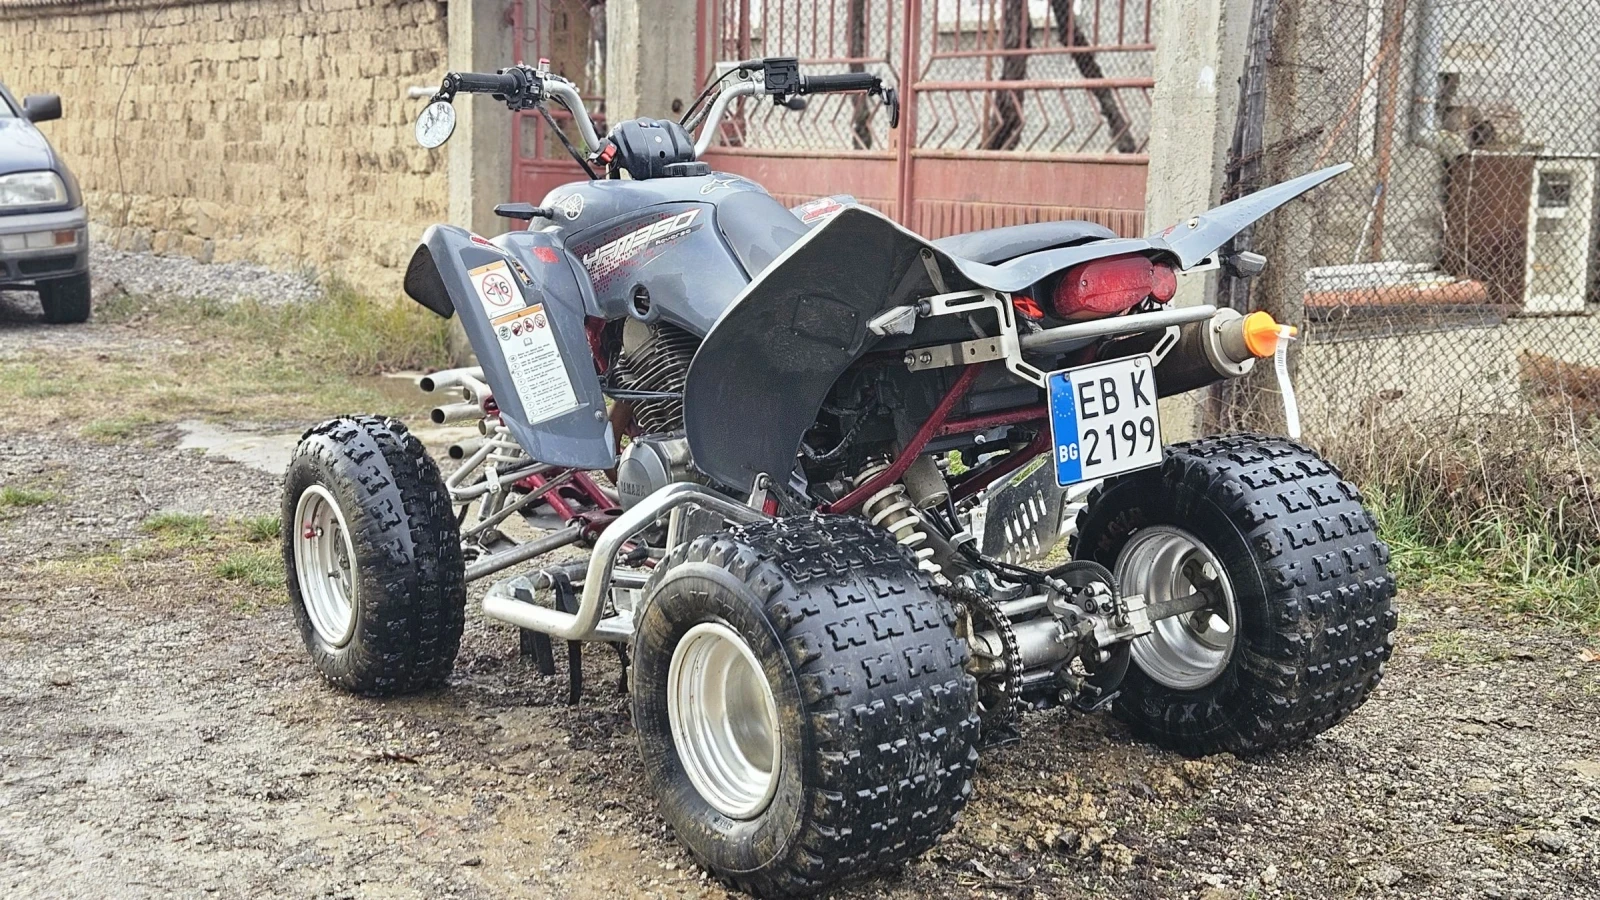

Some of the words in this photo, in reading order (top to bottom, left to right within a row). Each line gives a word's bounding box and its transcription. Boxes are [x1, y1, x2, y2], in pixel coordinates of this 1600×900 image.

[1078, 377, 1120, 420] EB
[1130, 369, 1151, 409] K
[1059, 443, 1079, 463] BG
[1083, 415, 1155, 467] 2199
